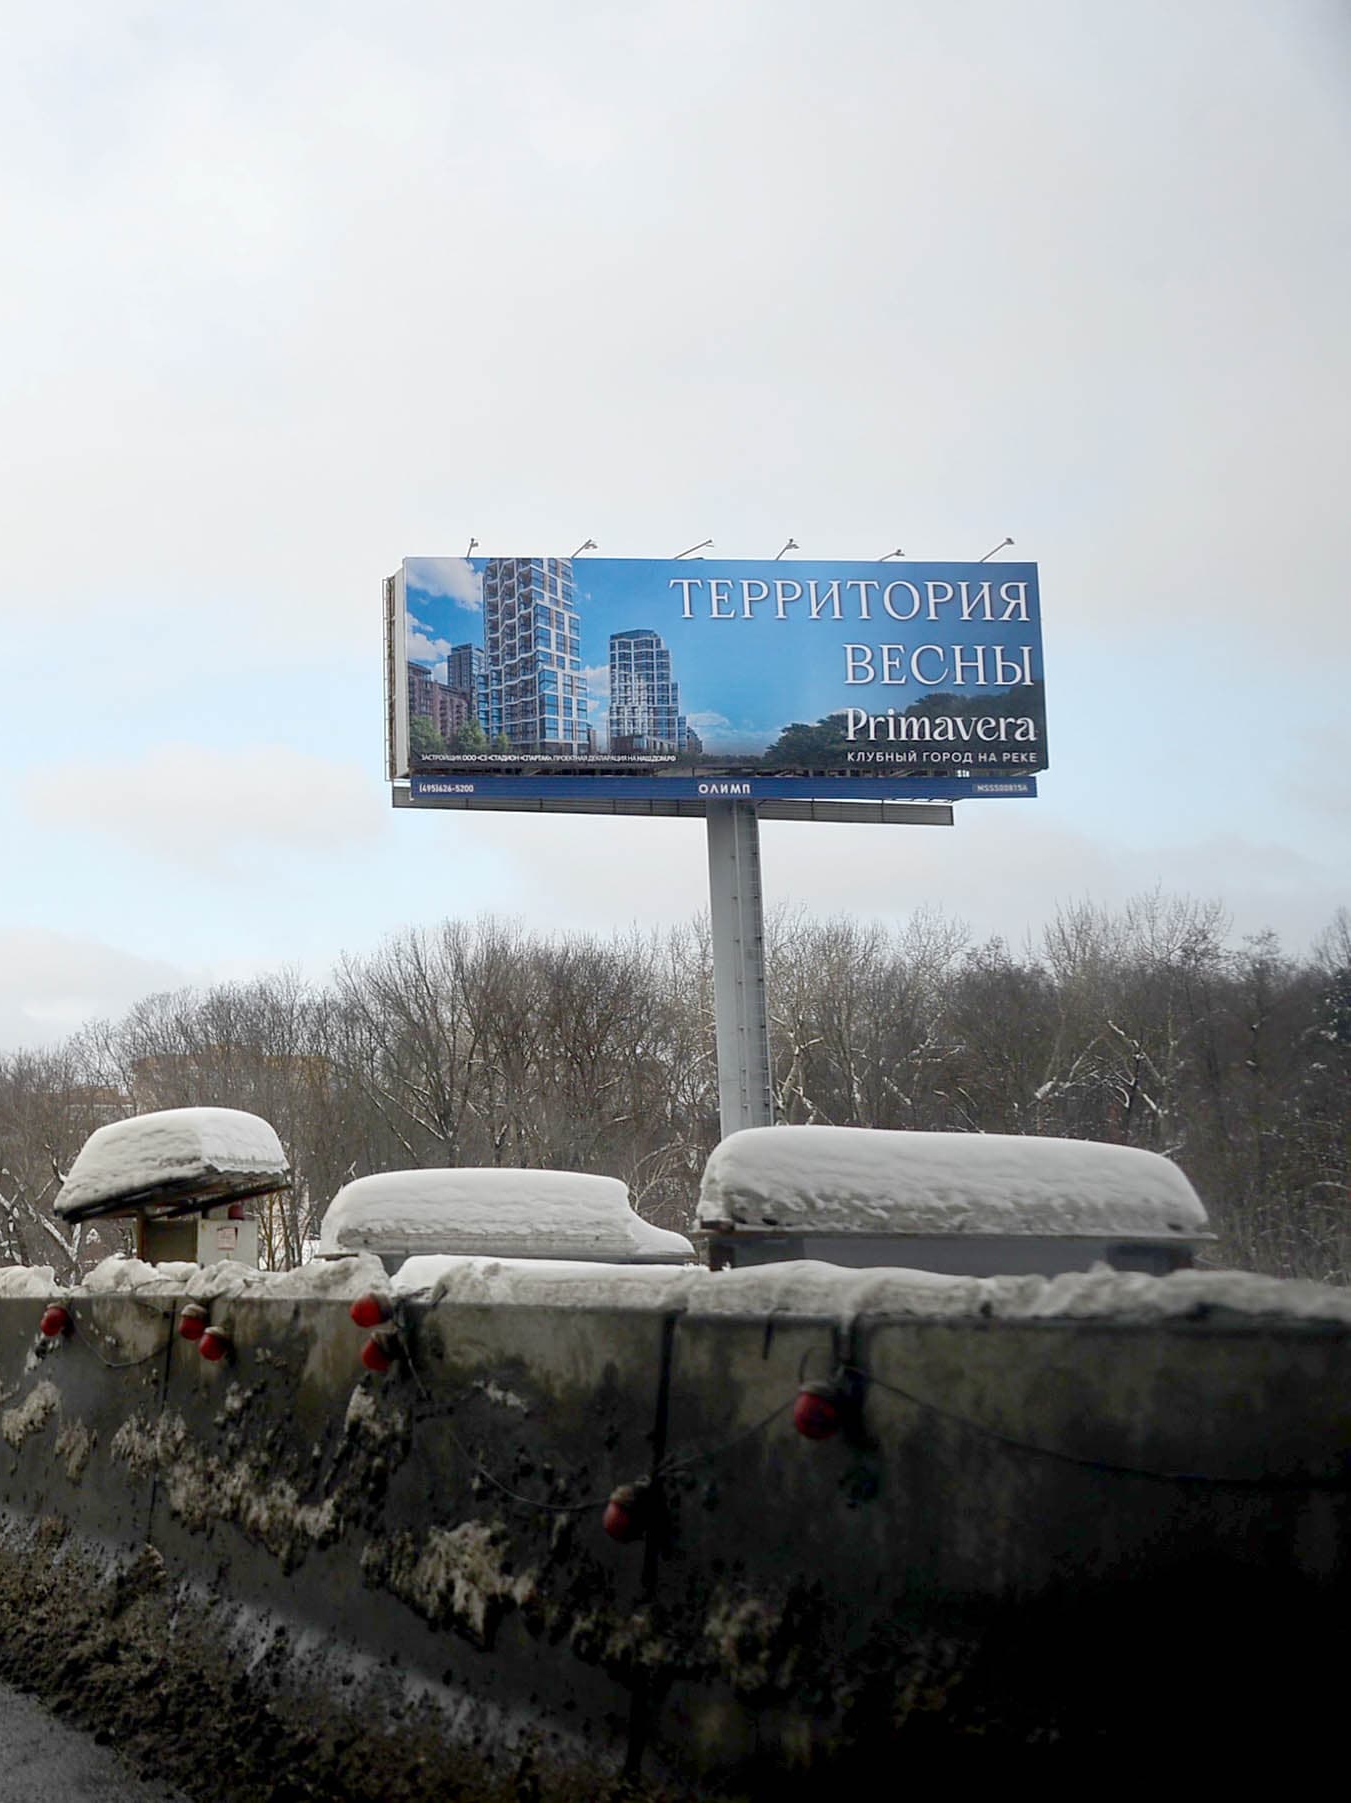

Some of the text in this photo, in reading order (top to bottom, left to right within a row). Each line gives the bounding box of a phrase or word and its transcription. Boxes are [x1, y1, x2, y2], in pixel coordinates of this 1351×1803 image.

[669, 579, 1030, 621] ТЕРРИТОРИЯ
[842, 644, 1034, 686] ВЕСНЫ
[845, 708, 1037, 741] Primavera
[847, 750, 1037, 763] КЛУБНЫЙ ГОРОД НА РЕКЕ
[419, 784, 474, 793] (495)626-5200
[698, 784, 751, 794] ОЛИМП
